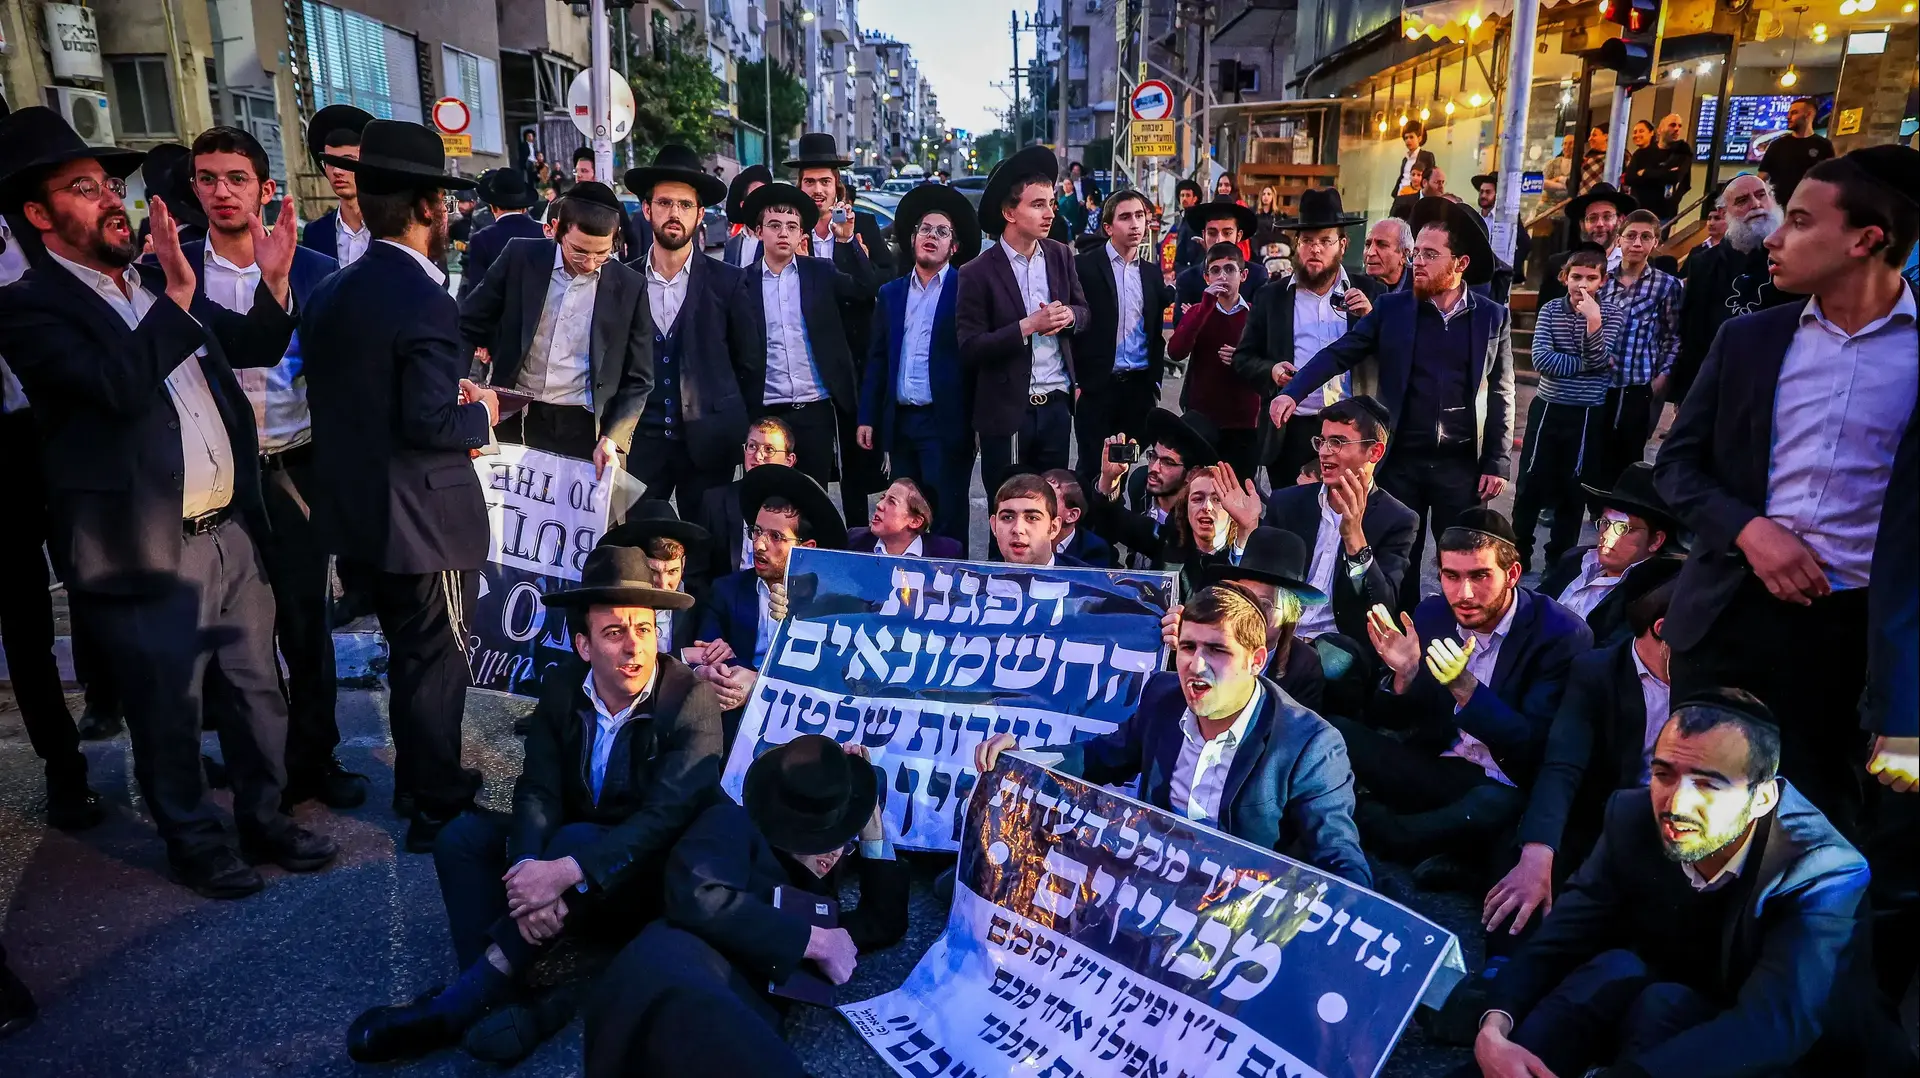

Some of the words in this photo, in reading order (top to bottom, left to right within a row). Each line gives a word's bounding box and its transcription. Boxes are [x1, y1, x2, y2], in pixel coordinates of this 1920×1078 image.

[1133, 134, 1151, 143] ישראל
[488, 461, 556, 505] THE
[567, 479, 599, 513] TO
[501, 510, 597, 573] BUT
[879, 565, 1070, 627] הפגנת
[778, 615, 1157, 706] החשמונאים
[758, 684, 903, 747] שלטון
[988, 775, 1110, 848] העדות
[1115, 807, 1190, 883] מכל
[986, 913, 1068, 973] זממם
[1031, 845, 1282, 1001] מכריזים
[1294, 882, 1401, 977] גדולי
[988, 966, 1042, 1010] מכם
[1059, 954, 1113, 995] רוע
[1107, 977, 1179, 1027] יפיקו
[1039, 992, 1093, 1041] אחד
[1090, 1018, 1169, 1078] אפילו
